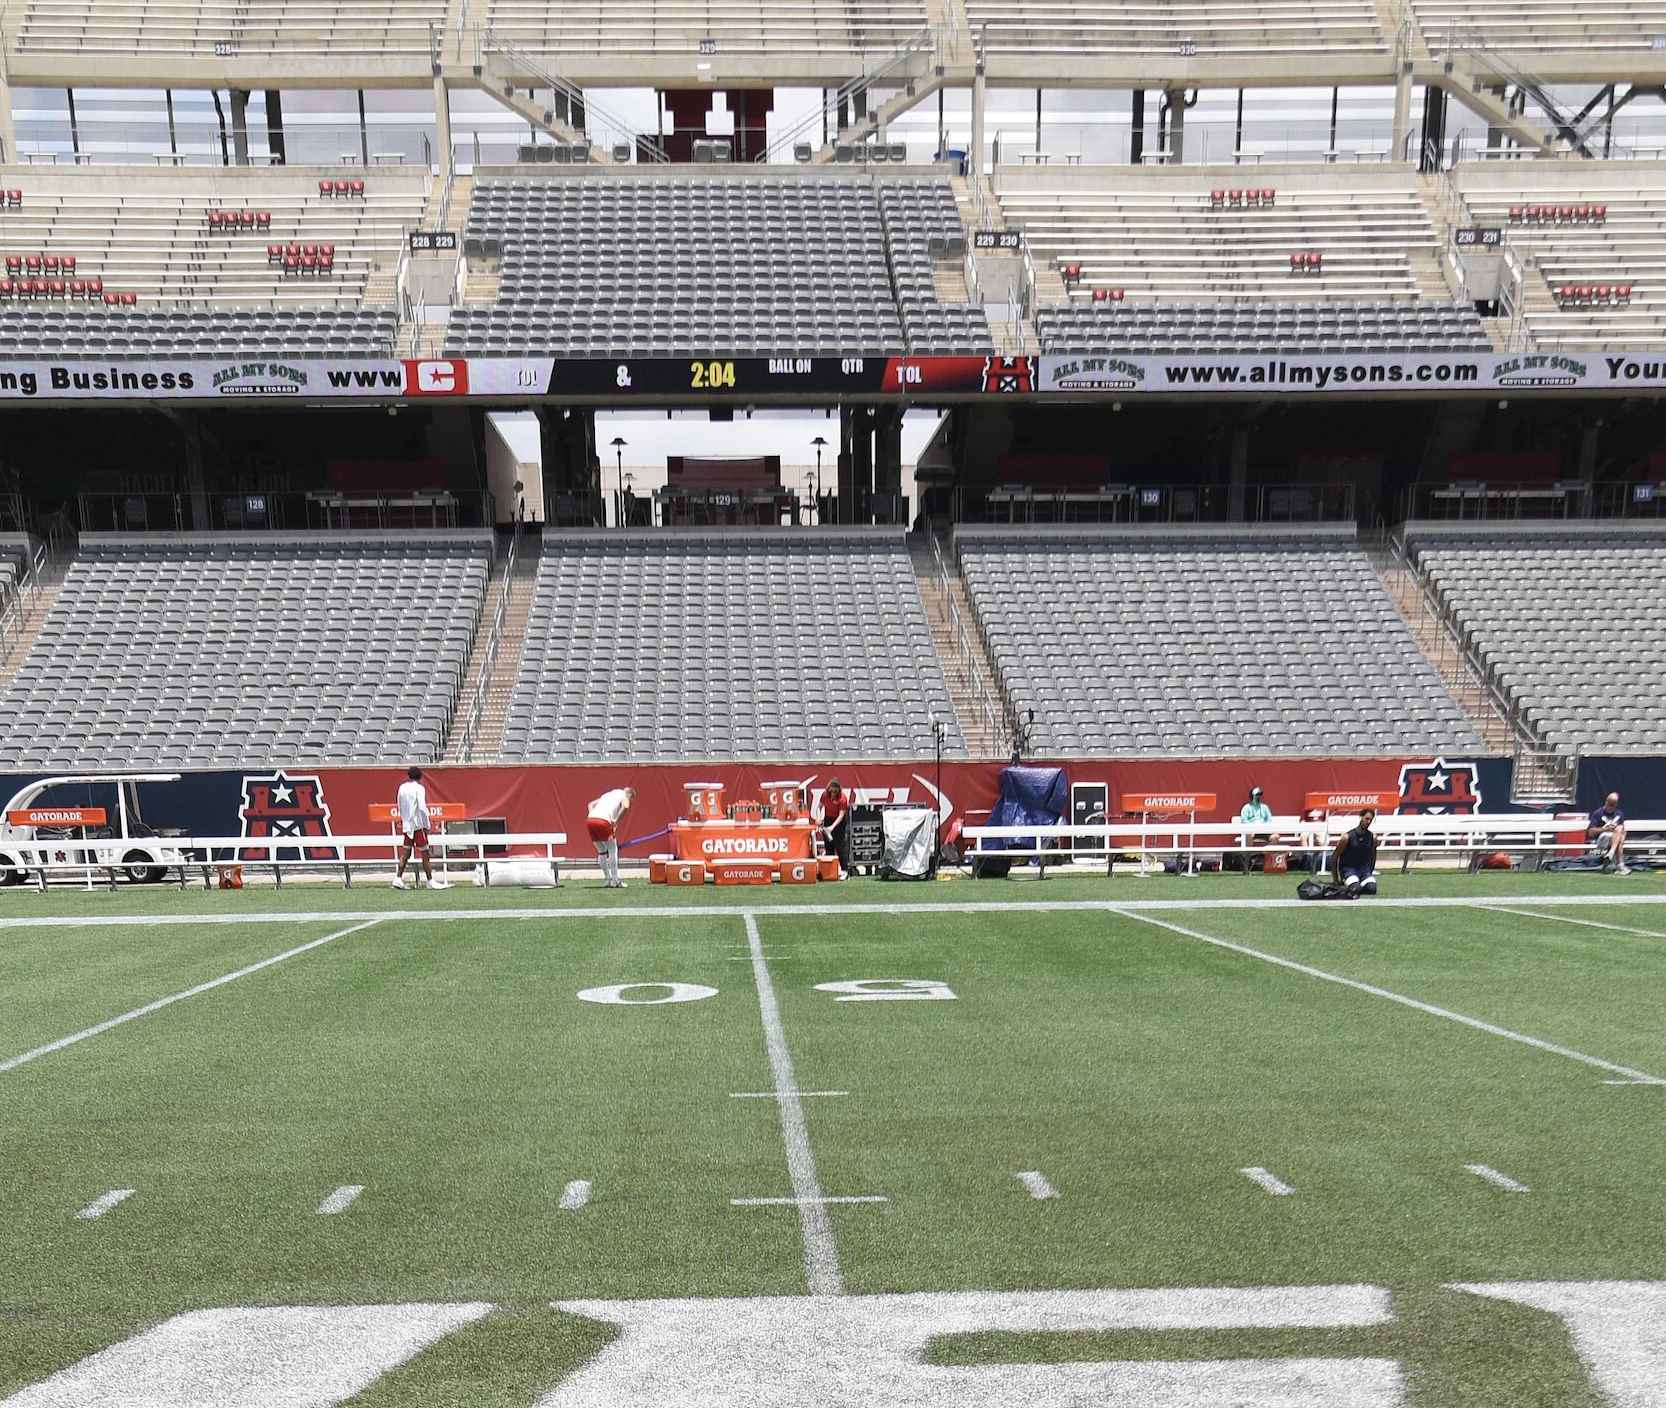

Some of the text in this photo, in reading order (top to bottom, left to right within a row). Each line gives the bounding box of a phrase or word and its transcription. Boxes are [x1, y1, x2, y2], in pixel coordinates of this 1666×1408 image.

[215, 43, 231, 54] 328
[1180, 44, 1196, 54] 330
[412, 236, 453, 247] 228 229
[977, 236, 1017, 246] 229 230
[1458, 232, 1498, 243] 230 231
[769, 359, 812, 374] BALL ON
[841, 359, 864, 374] QTR
[1053, 359, 1146, 384] ALL MY SONS
[1493, 356, 1586, 380] ALL MY SONS
[51, 367, 194, 390] Business
[213, 364, 307, 386] ALL MY SONS
[617, 366, 631, 387] &
[691, 362, 736, 388] 2:04
[896, 366, 922, 384] TOL
[1165, 361, 1478, 388] www.allmysons.com
[263, 385, 297, 393] STORAGE
[1143, 494, 1158, 503] 130
[1636, 489, 1650, 499] 131
[248, 500, 264, 510] 128
[715, 496, 731, 506] 129
[691, 792, 701, 805] G
[783, 790, 793, 804] G
[1144, 797, 1196, 807] GATORADE
[1328, 795, 1379, 805] GATORADE
[29, 812, 83, 822] GATORADE
[701, 838, 789, 854] GATORADE
[223, 870, 232, 878] G
[679, 867, 692, 881] G
[723, 870, 764, 878] GATORADE
[792, 866, 805, 881] G
